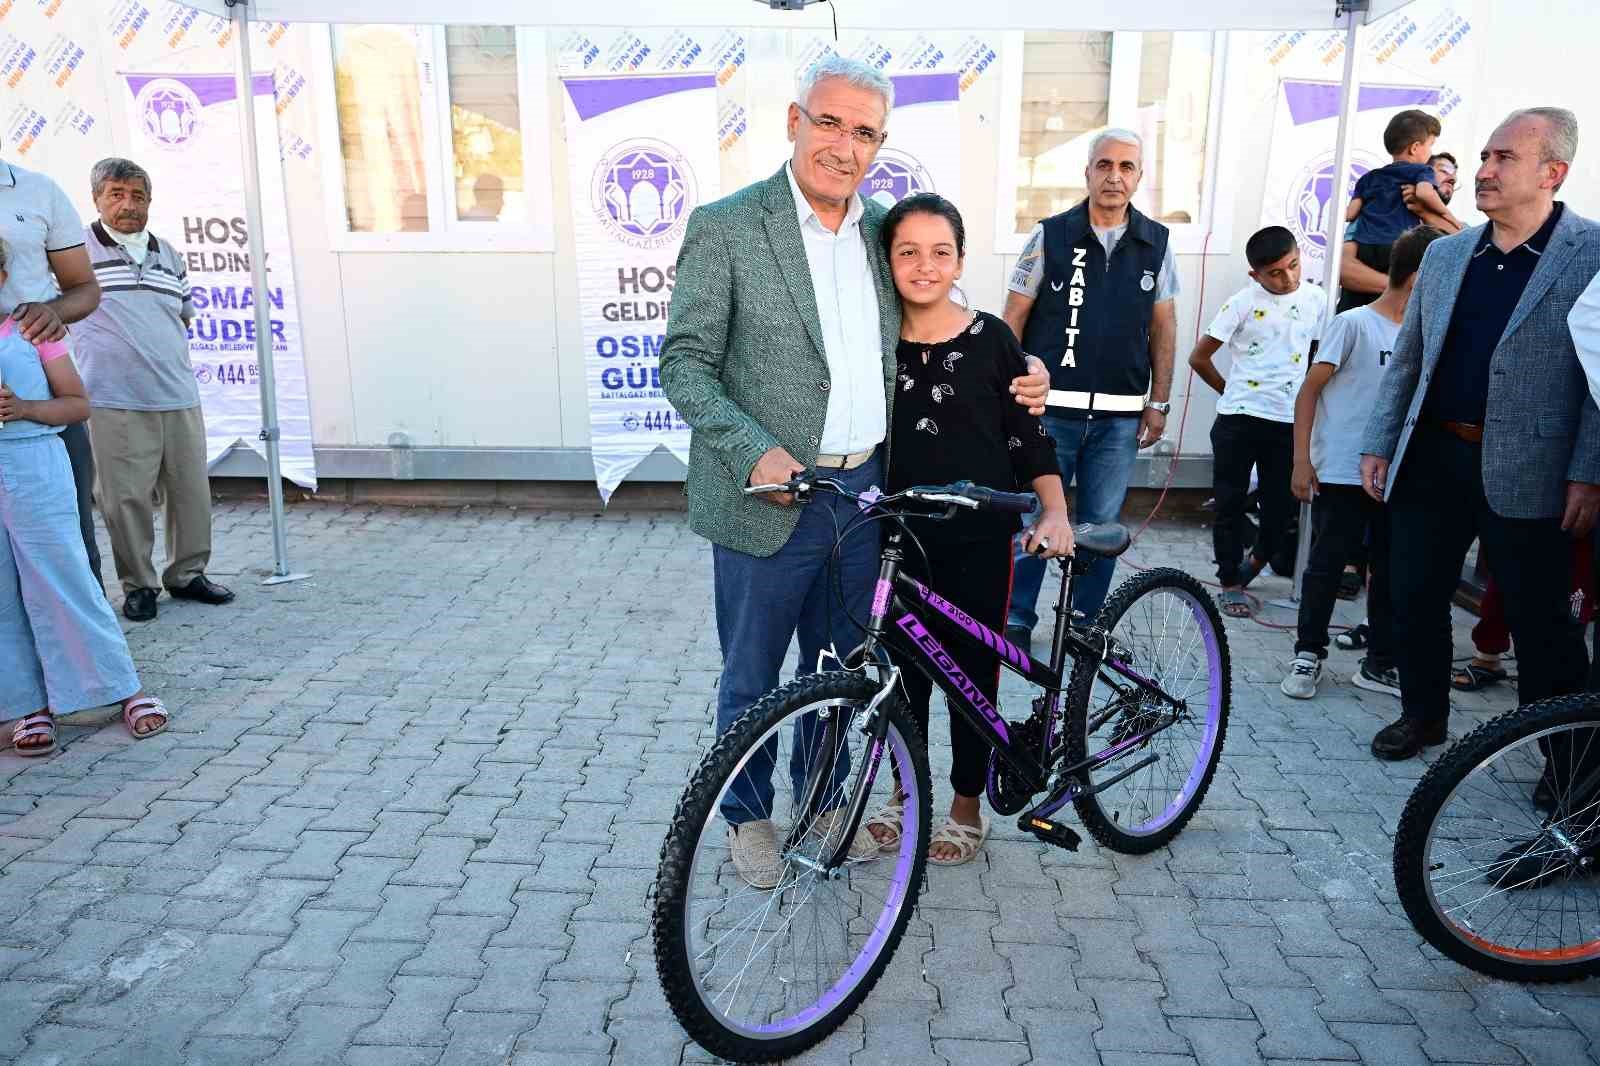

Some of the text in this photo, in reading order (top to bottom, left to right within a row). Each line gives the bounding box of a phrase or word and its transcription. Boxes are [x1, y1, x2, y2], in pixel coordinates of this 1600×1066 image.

[632, 168, 655, 180] 1928
[870, 177, 894, 190] 1928
[182, 216, 249, 249] HOŞ
[180, 252, 273, 273] ELDİN
[191, 286, 285, 310] SMAN
[1060, 247, 1088, 368] ZABITA
[602, 301, 671, 322] GELDİ
[184, 313, 288, 343] ÜDER
[596, 335, 666, 358] OSM
[217, 364, 246, 385] 444
[643, 410, 673, 431] 444
[902, 616, 1001, 725] LEGANO
